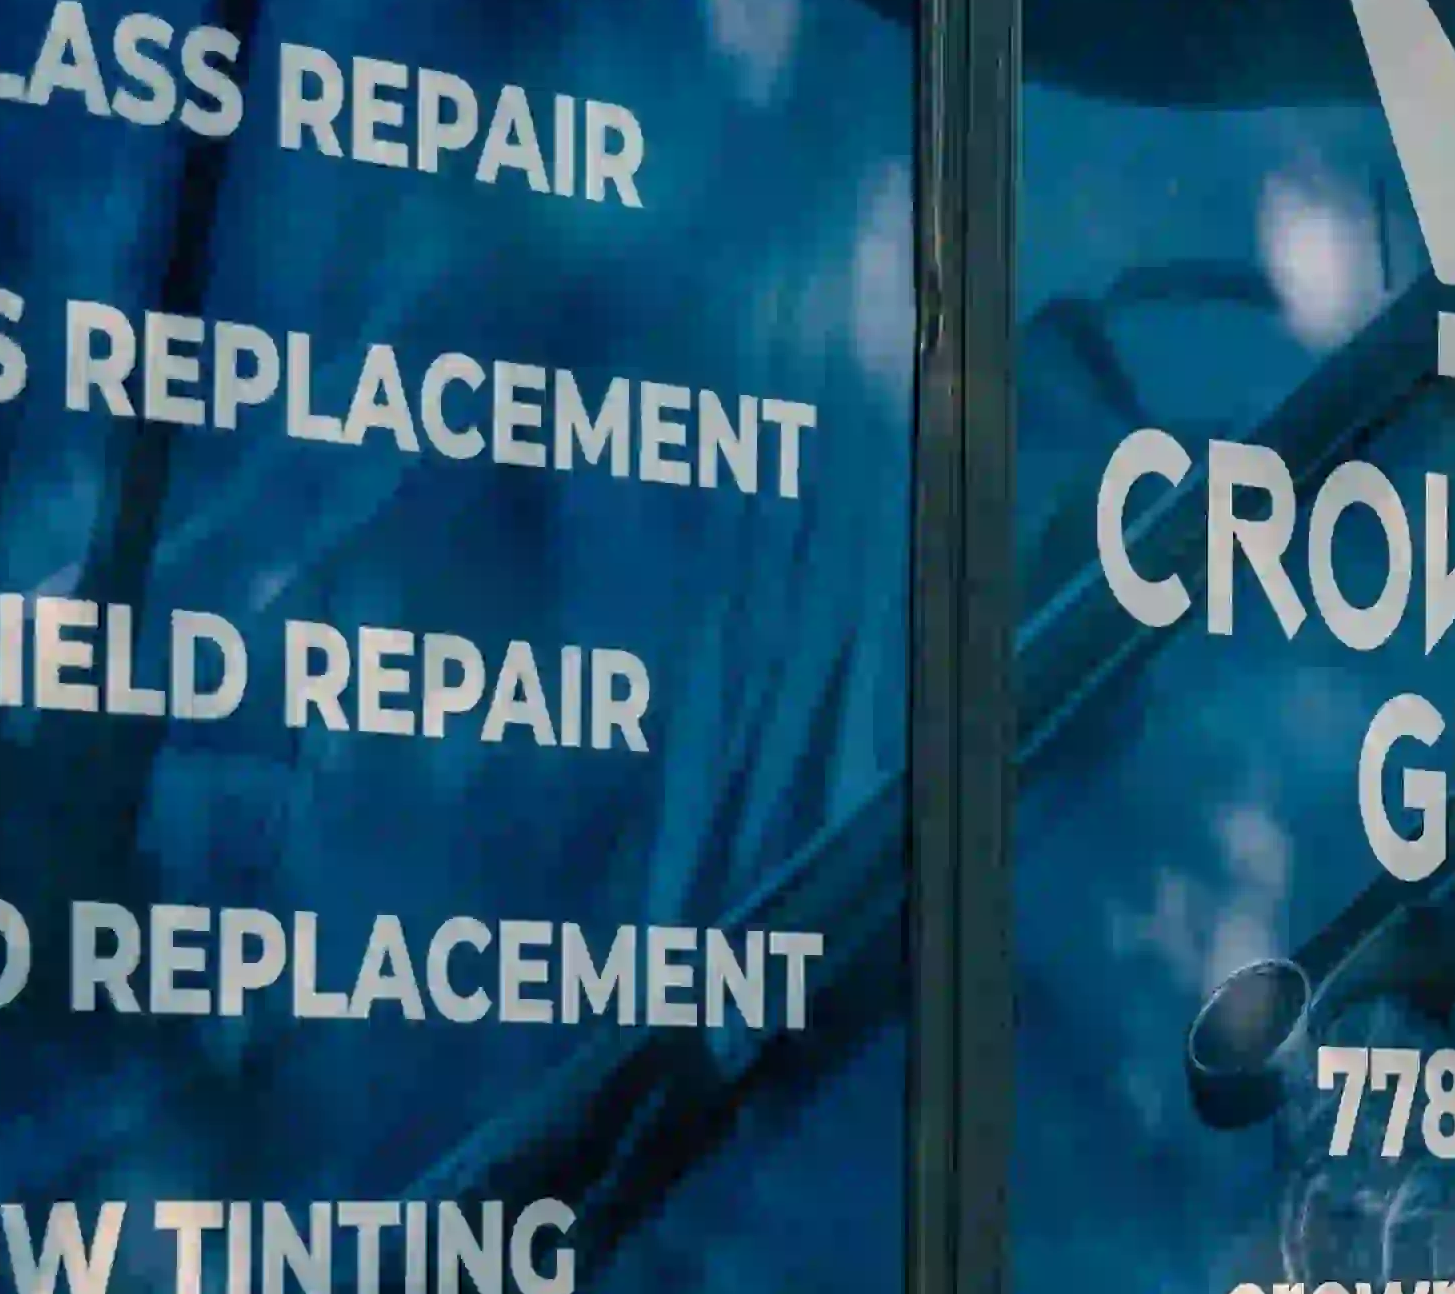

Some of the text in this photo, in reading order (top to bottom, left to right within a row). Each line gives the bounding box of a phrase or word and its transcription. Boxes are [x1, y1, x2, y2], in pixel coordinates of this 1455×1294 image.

[280, 42, 645, 207] REPAIR
[66, 300, 816, 500] REPLACEMENT
[284, 621, 650, 753] REPAIR
[69, 902, 823, 1031] REPLACEMENT
